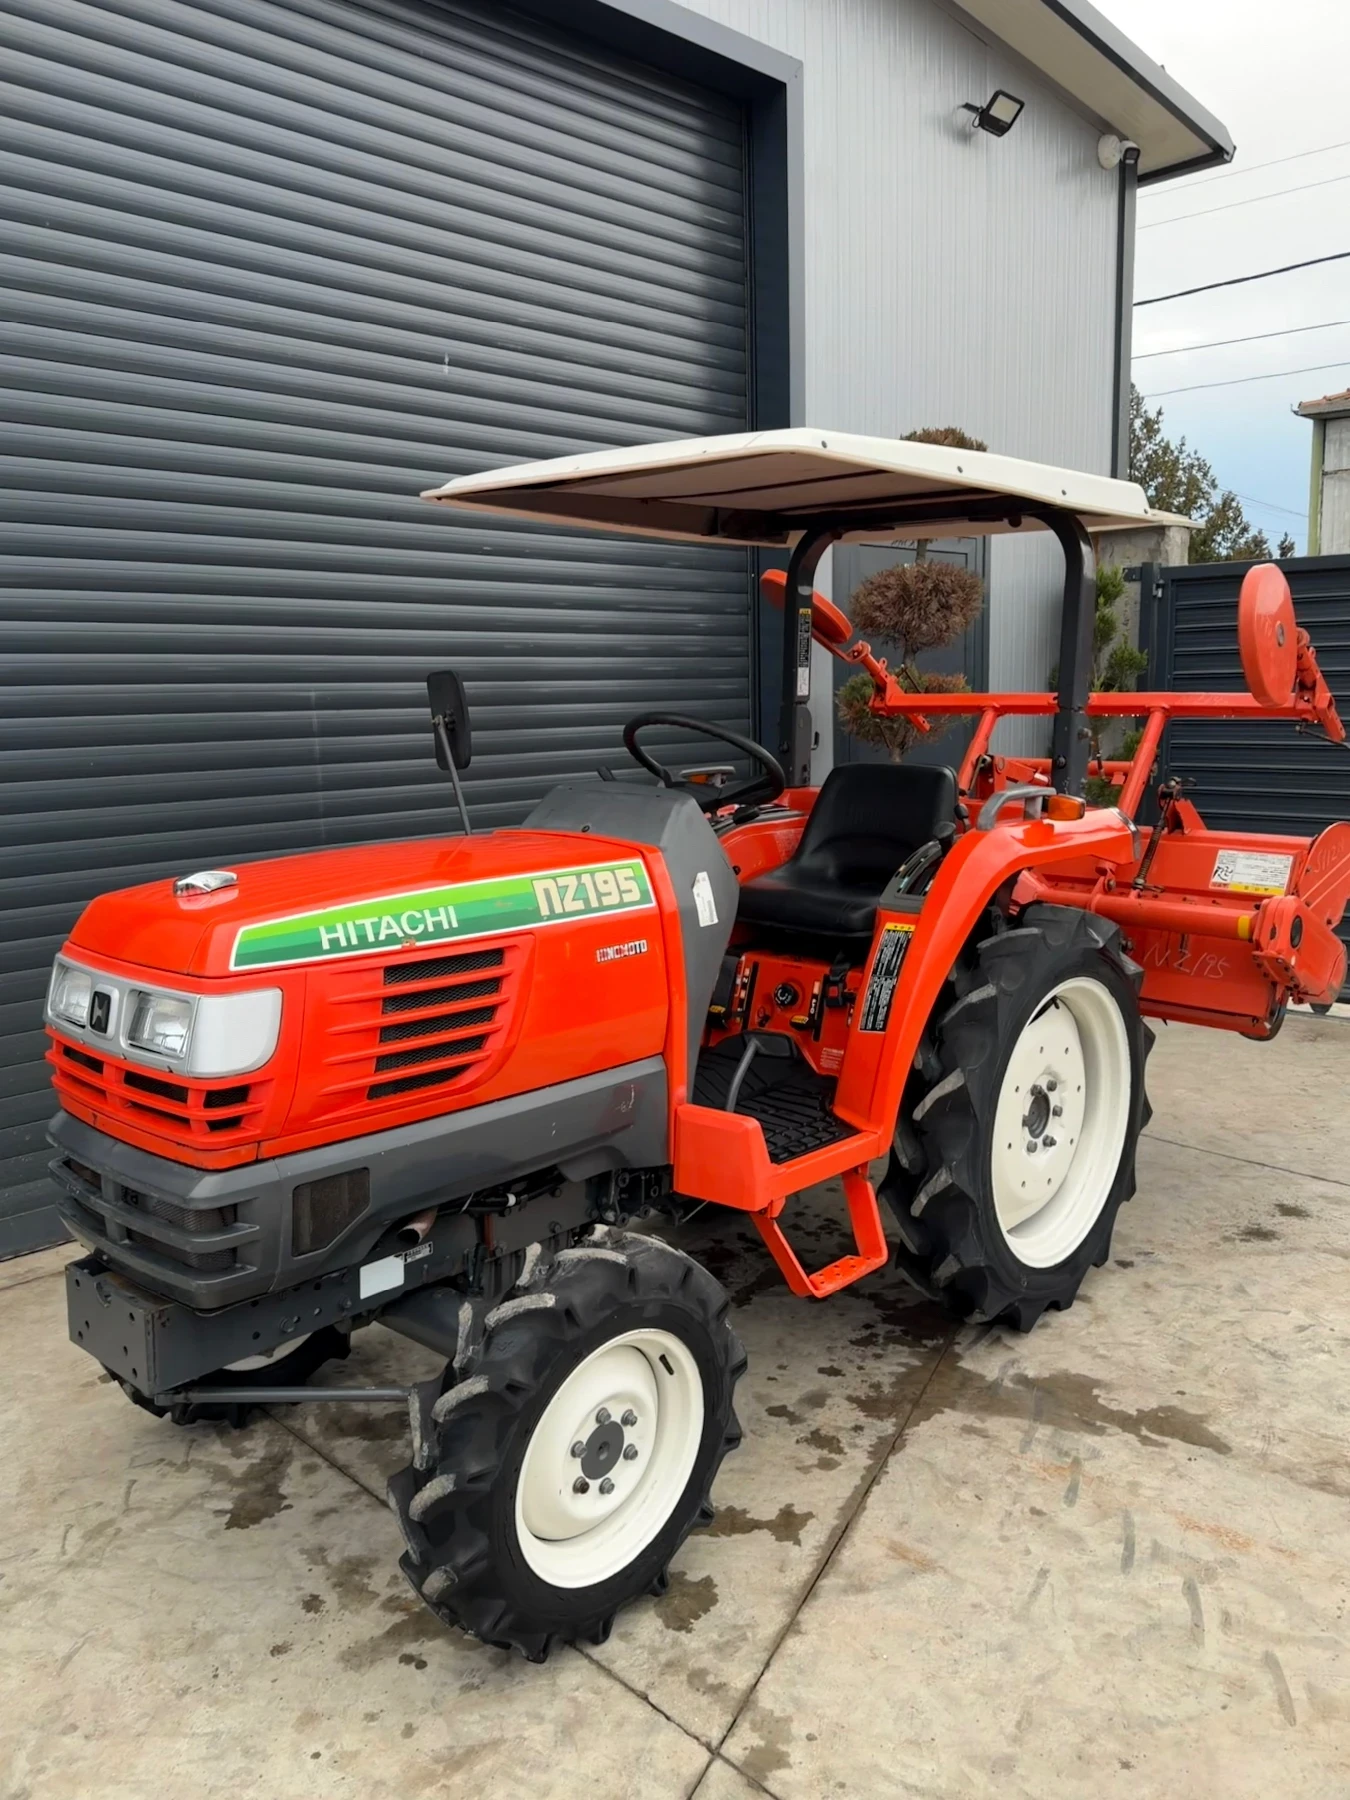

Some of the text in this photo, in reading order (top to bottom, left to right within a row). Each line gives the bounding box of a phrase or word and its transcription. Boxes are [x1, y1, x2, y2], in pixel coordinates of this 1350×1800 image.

[531, 867, 641, 917] NZ195
[318, 905, 459, 951] HITACHI
[596, 939, 648, 962] HINOMOTO
